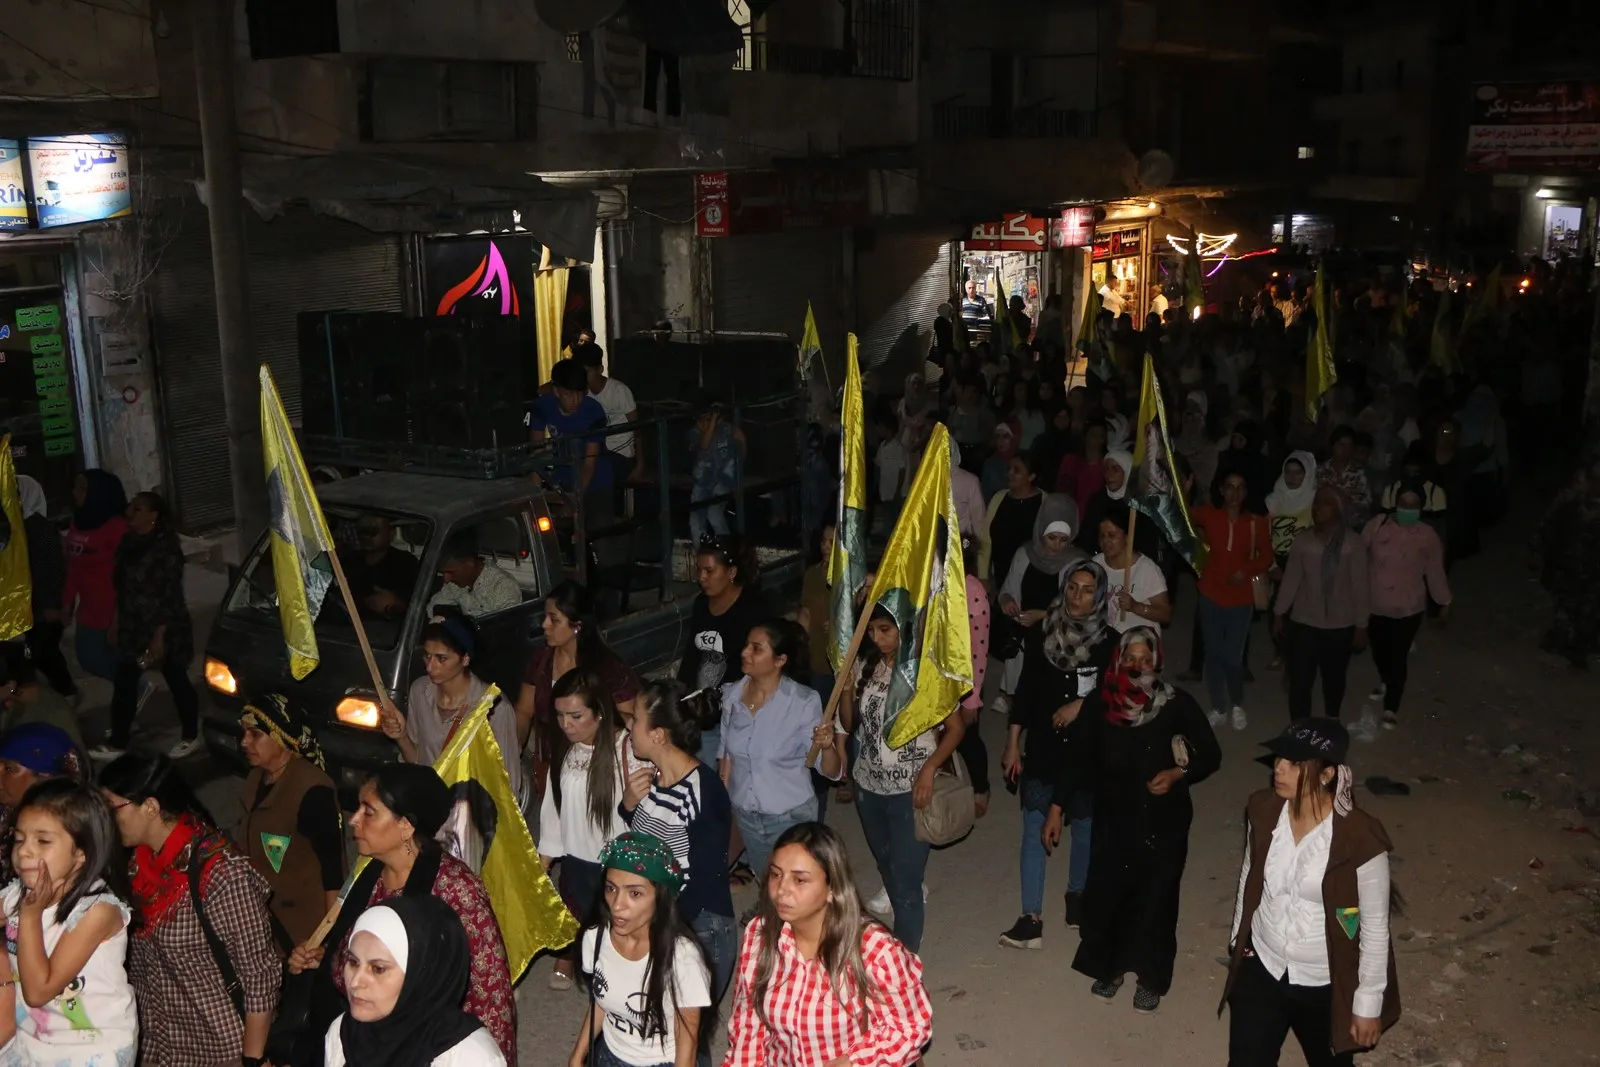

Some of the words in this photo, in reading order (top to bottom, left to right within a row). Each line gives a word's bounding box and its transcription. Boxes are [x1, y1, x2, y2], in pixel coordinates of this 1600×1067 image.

[74, 148, 117, 172] عفرين
[34, 339, 59, 351] دمشق
[886, 769, 908, 780] YOU
